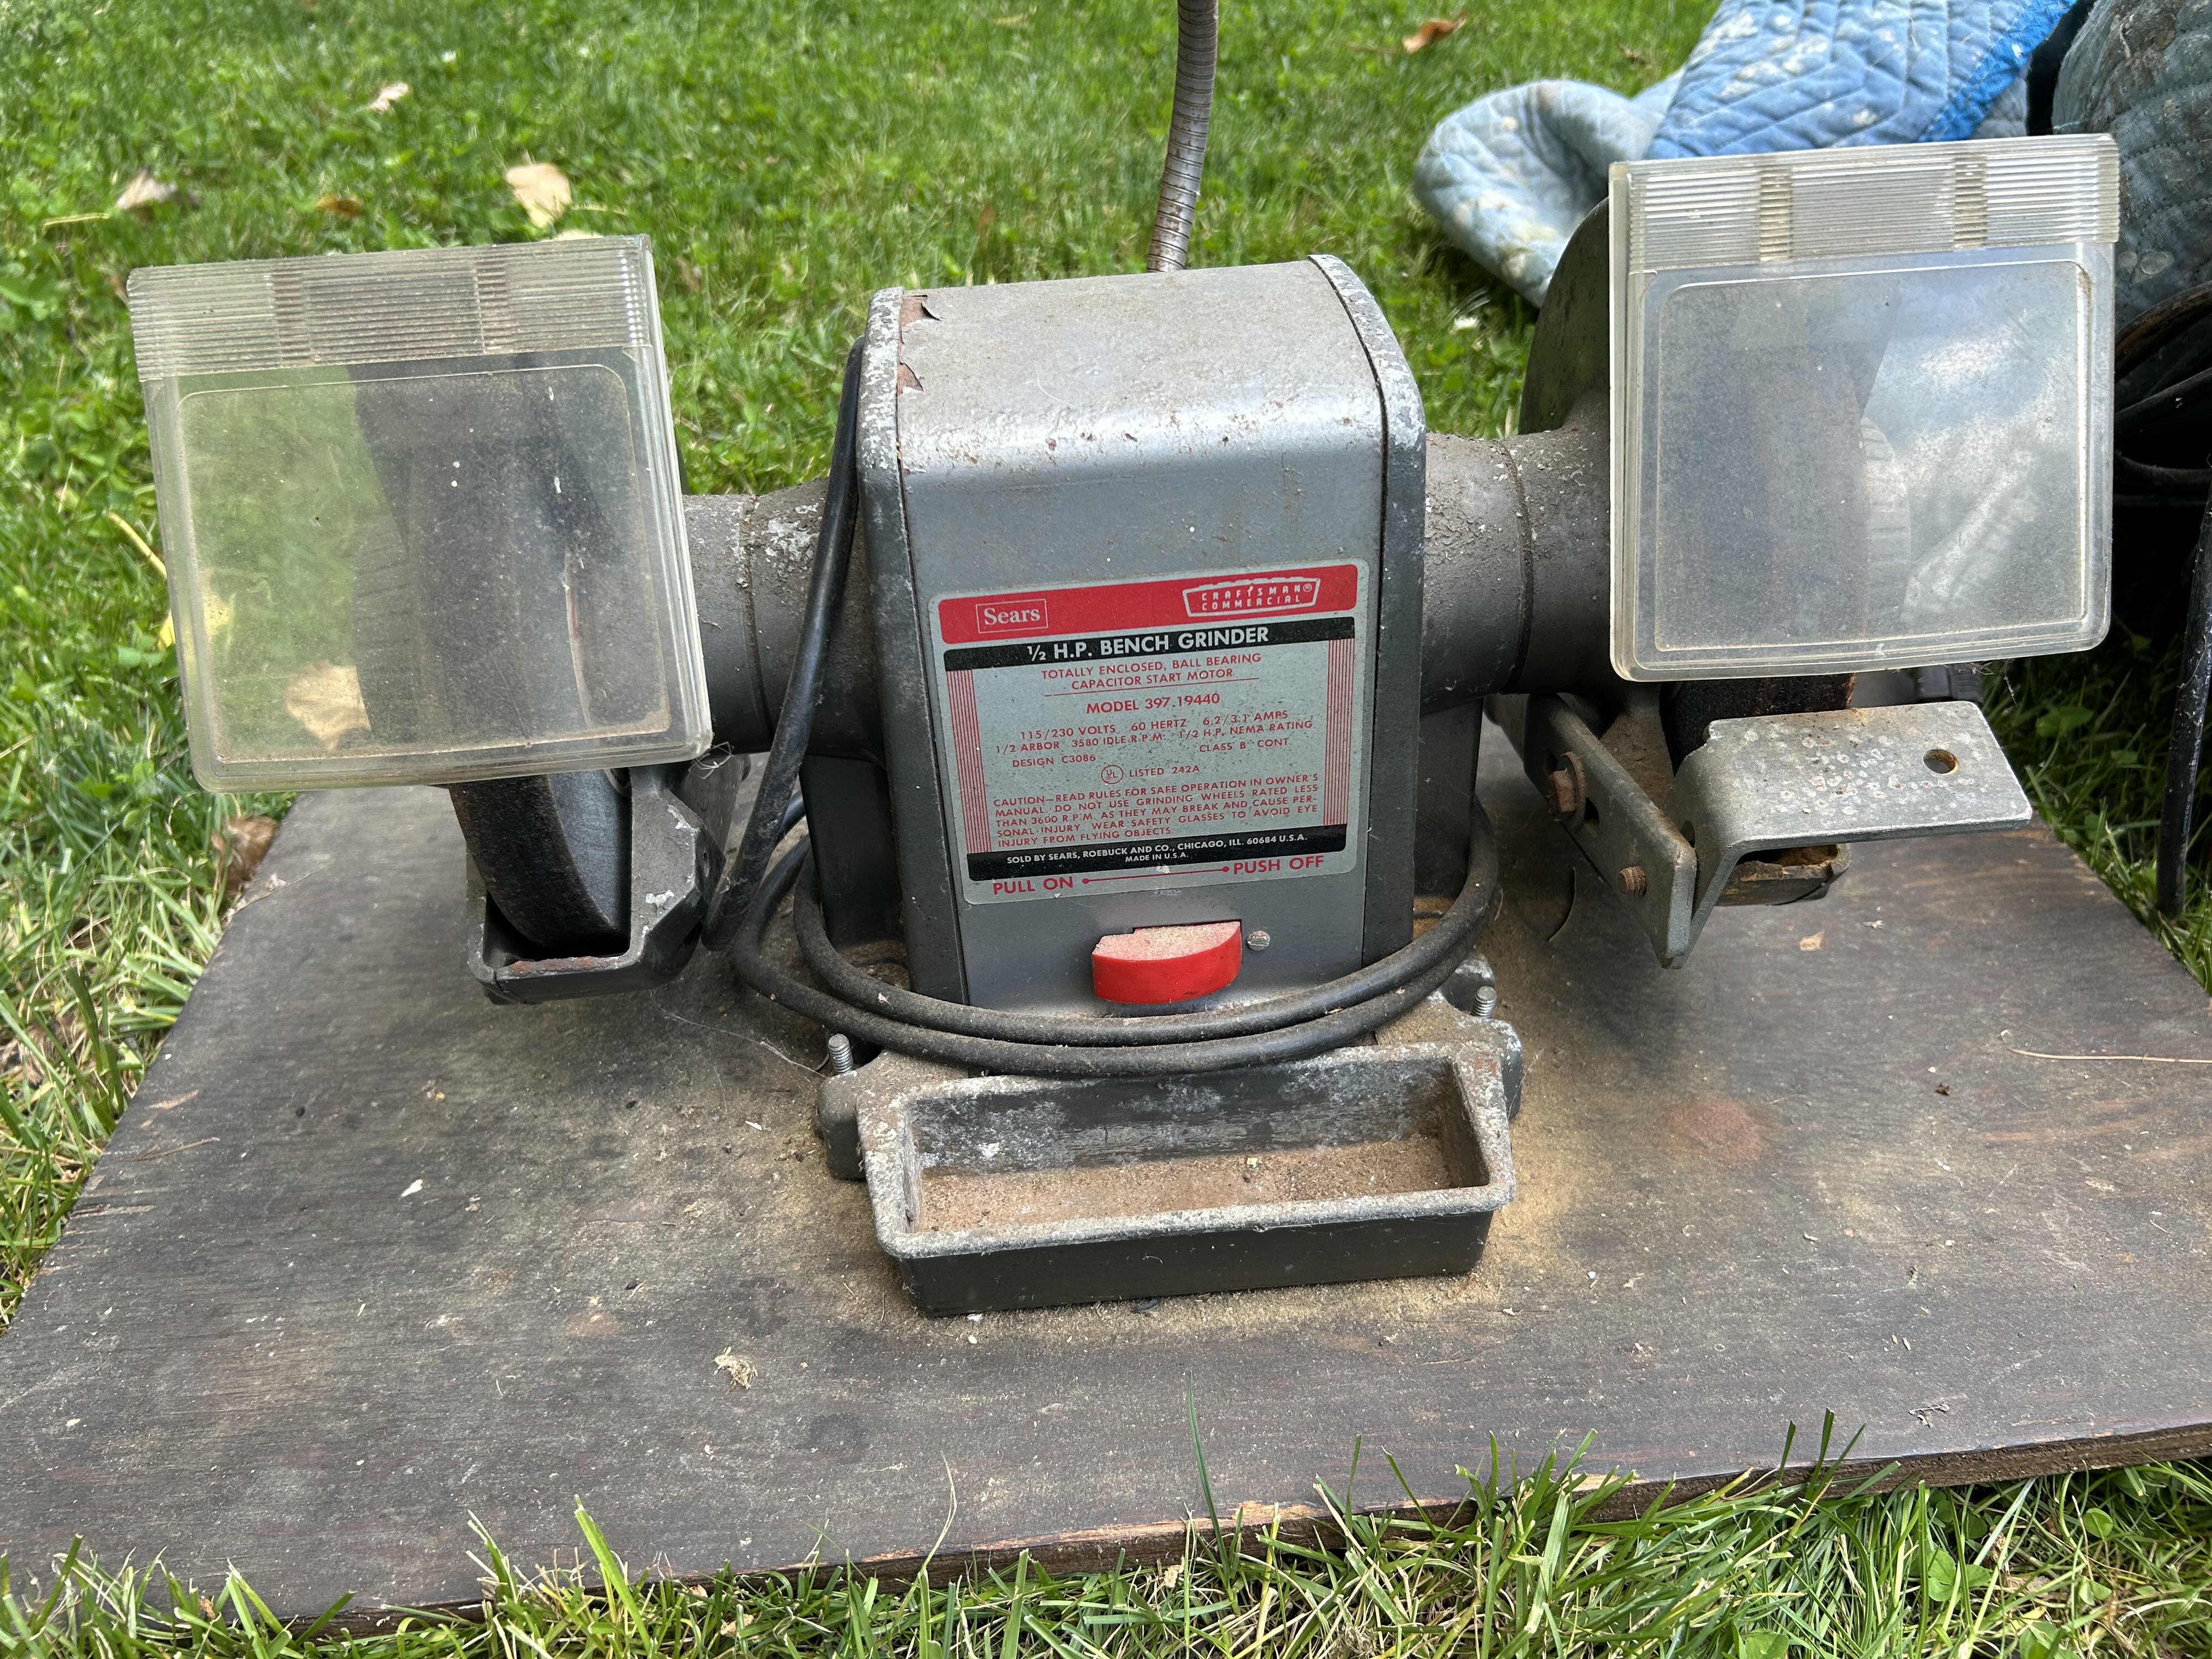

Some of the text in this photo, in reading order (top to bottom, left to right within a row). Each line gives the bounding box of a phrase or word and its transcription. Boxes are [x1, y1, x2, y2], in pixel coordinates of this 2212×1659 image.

[984, 607, 1041, 625] Sears
[1201, 595, 1300, 611] COMMERCIAL
[1054, 642, 1093, 659] H.P.
[1101, 635, 1169, 656] BENCH
[1178, 627, 1268, 649] GRINDER
[1041, 653, 1261, 679] TOTALLY ENCLOSED, BALL BEARING
[1071, 668, 1233, 690] CAPACITOR START MOTOR
[1086, 699, 1139, 714] MODEL
[996, 744, 1016, 755] 1/2
[1021, 741, 1059, 752] ARBOR
[1071, 738, 1098, 748] 3580
[1103, 736, 1126, 746] IDLE
[1179, 730, 1198, 741] 1/2
[1204, 728, 1225, 737] H.P.
[1230, 724, 1264, 735] NEMA
[1269, 720, 1312, 732] RATING
[1021, 710, 1288, 740] 115/230 VOLTS 60 HERTZ 6.2/3.1 AMPS
[1012, 757, 1054, 768] DESIGN
[1062, 754, 1096, 764] C3086
[1200, 743, 1232, 753] CLASS
[1129, 768, 1164, 777] LISTED
[1172, 765, 1200, 774] 242A
[1054, 804, 1071, 813] DO
[1079, 802, 1103, 811] NOT
[1109, 799, 1128, 808] USE
[1136, 794, 1193, 806] GRINDING
[1201, 790, 1244, 801] WHEELS
[1252, 786, 1287, 797] RATED
[1295, 784, 1318, 793] LESS
[1089, 789, 1121, 799] RULES
[1125, 787, 1147, 796] FOR
[1150, 785, 1177, 794] SAFE
[1181, 779, 1246, 792] OPERATION
[1250, 778, 1261, 787] IN
[1265, 772, 1318, 785] OWNER'S
[996, 818, 1027, 828] THAN
[1031, 815, 1058, 825] 3600
[1101, 810, 1114, 819] AS
[1119, 808, 1146, 818] THEY
[1152, 806, 1177, 815] MAY
[1182, 803, 1218, 812] BREAK
[1223, 800, 1248, 810] AND
[1252, 797, 1288, 807] CAUSE
[1293, 795, 1317, 804] PER-
[997, 828, 1034, 838] SONAL
[1092, 820, 1124, 830] WEAR
[1131, 816, 1170, 827] SAFETY
[1178, 812, 1224, 823] GLASSES
[1232, 810, 1245, 819] TO
[1254, 807, 1290, 817] AVOID
[1297, 805, 1317, 814] EYE
[998, 827, 1171, 848] INJURY FROM FLYING OBJECTS
[1007, 855, 1031, 864] SOLD
[1034, 853, 1045, 862] BY
[1048, 851, 1080, 860] SEARS,
[1083, 848, 1127, 858] ROEBUCK
[1130, 845, 1152, 854] AND
[1155, 844, 1175, 853] CO.,
[1177, 840, 1226, 851] CHICAGO,
[1246, 836, 1277, 845] 60684
[1279, 833, 1307, 842] U.S.A.
[993, 855, 1323, 895] PULL ON PUSH OFF
